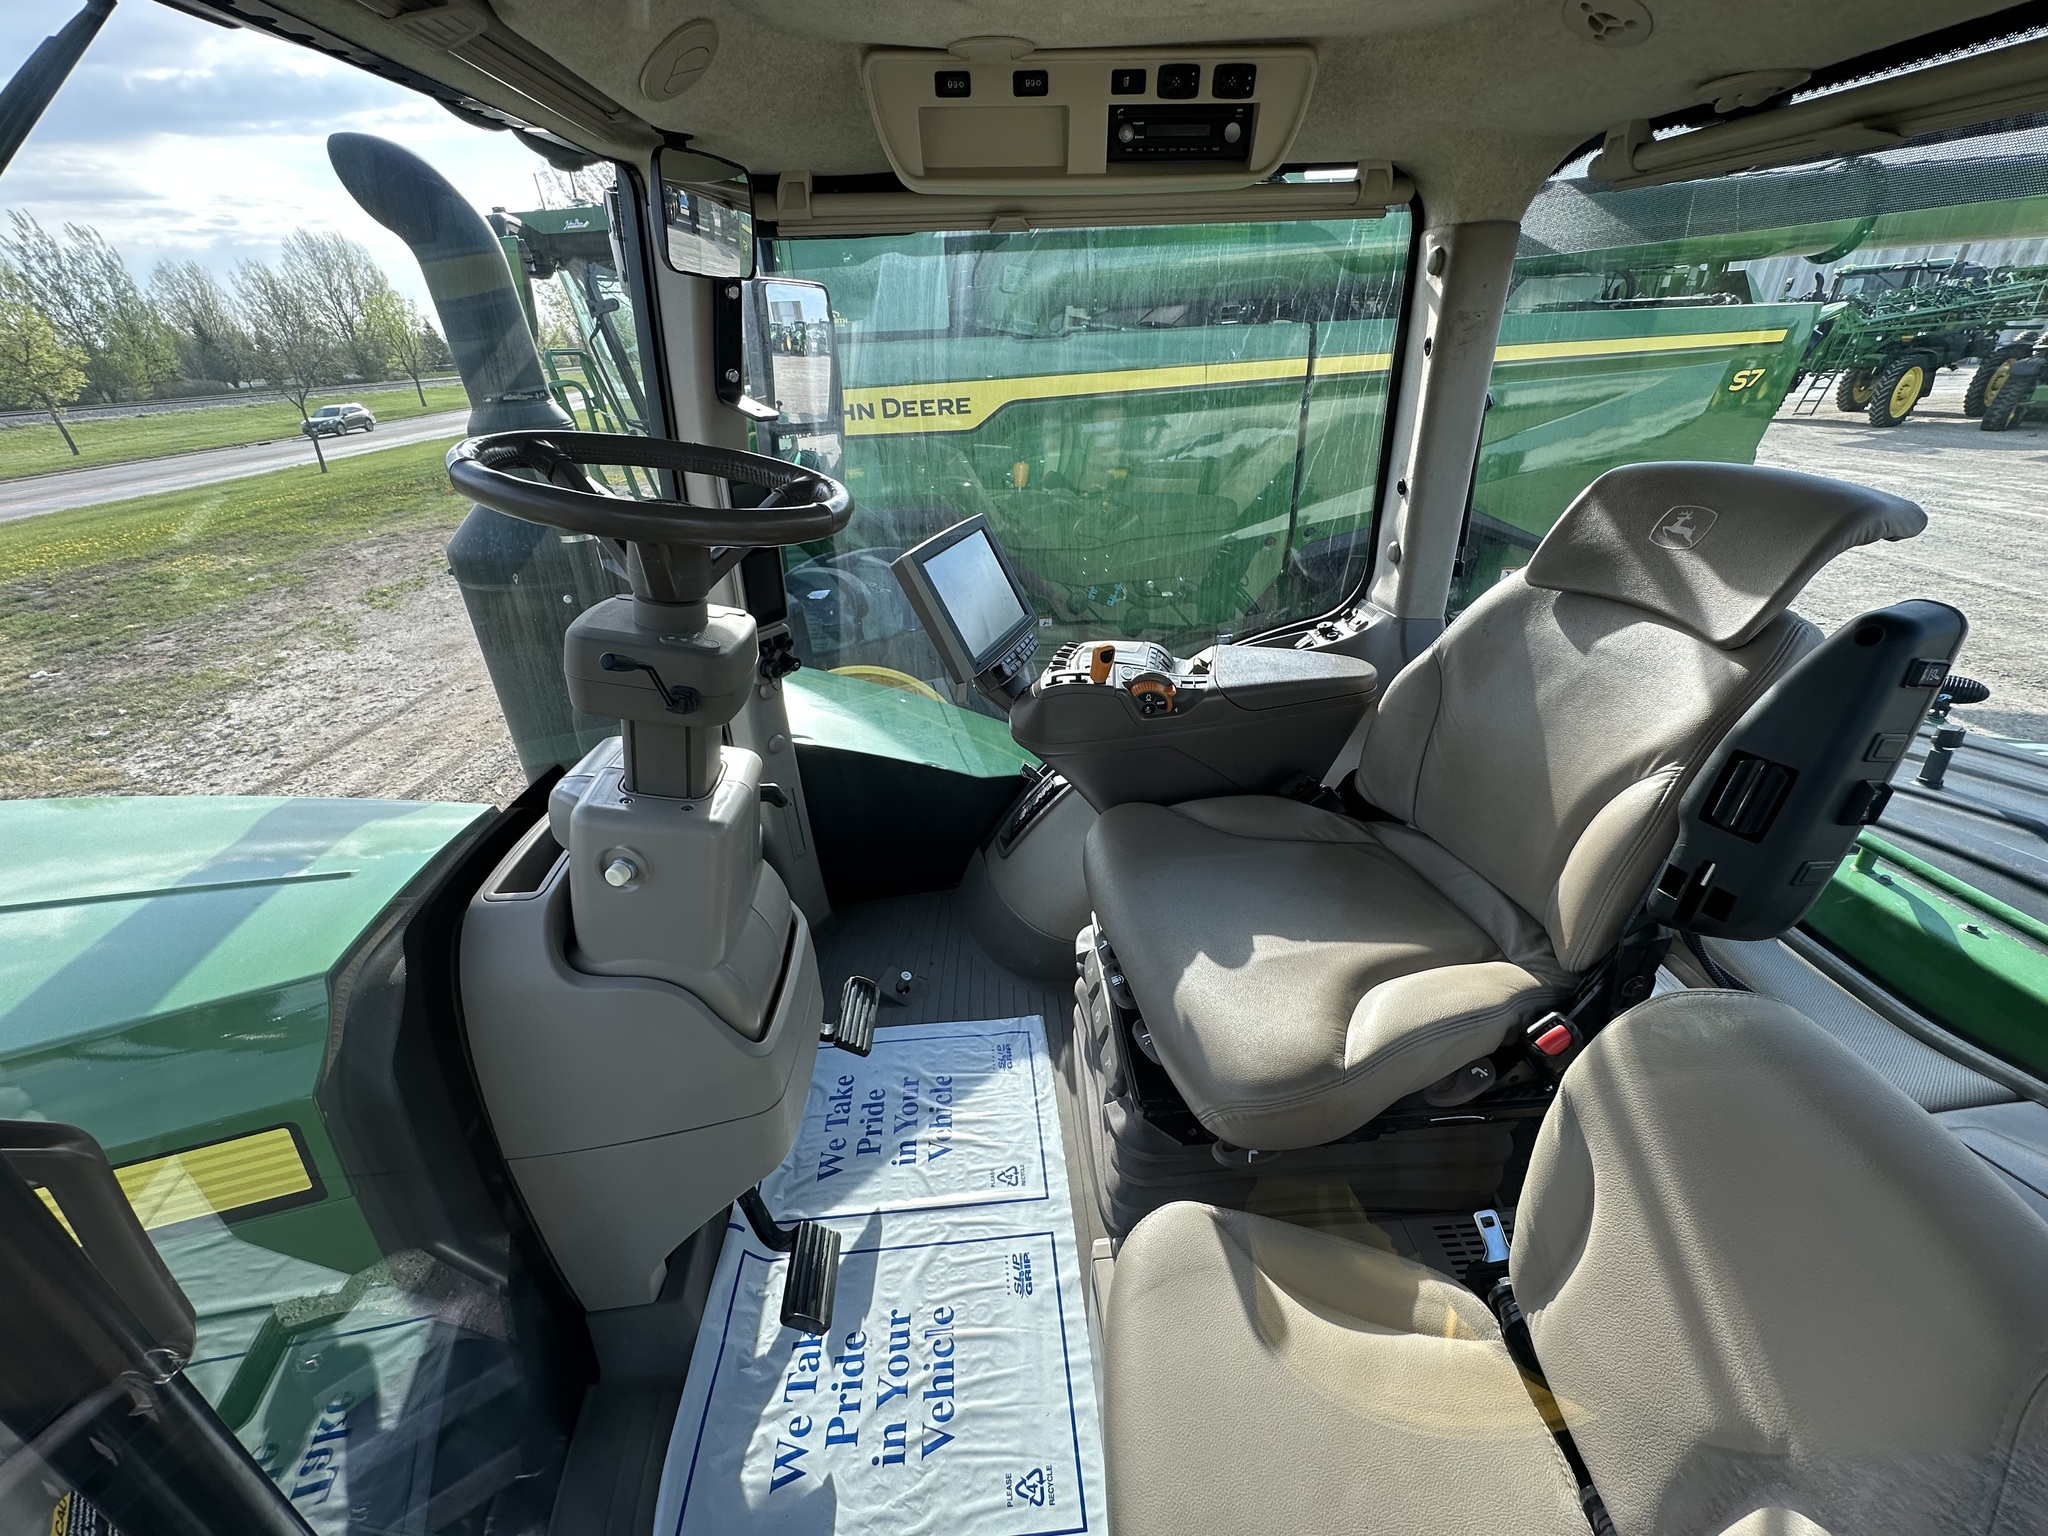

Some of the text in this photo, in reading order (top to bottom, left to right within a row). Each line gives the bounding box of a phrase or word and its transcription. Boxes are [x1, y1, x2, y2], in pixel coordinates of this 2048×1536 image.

[844, 397, 972, 421] HN DEERE
[1728, 368, 1766, 392] S7
[817, 1074, 855, 1183] We Take
[855, 1087, 887, 1158] Pride
[890, 1076, 920, 1167] in Your
[926, 1074, 954, 1163] Vehicle
[1019, 1164, 1027, 1187] RECYCLE
[1011, 1253, 1022, 1296] SLIP
[1022, 1252, 1033, 1296] GRIP
[769, 1331, 825, 1495] We Tak
[824, 1329, 868, 1450] Pride
[871, 1308, 913, 1468] in Your
[921, 1305, 956, 1462] Vehicle
[1005, 1473, 1013, 1508] PLEASE
[1048, 1464, 1056, 1507] RECYCLE
